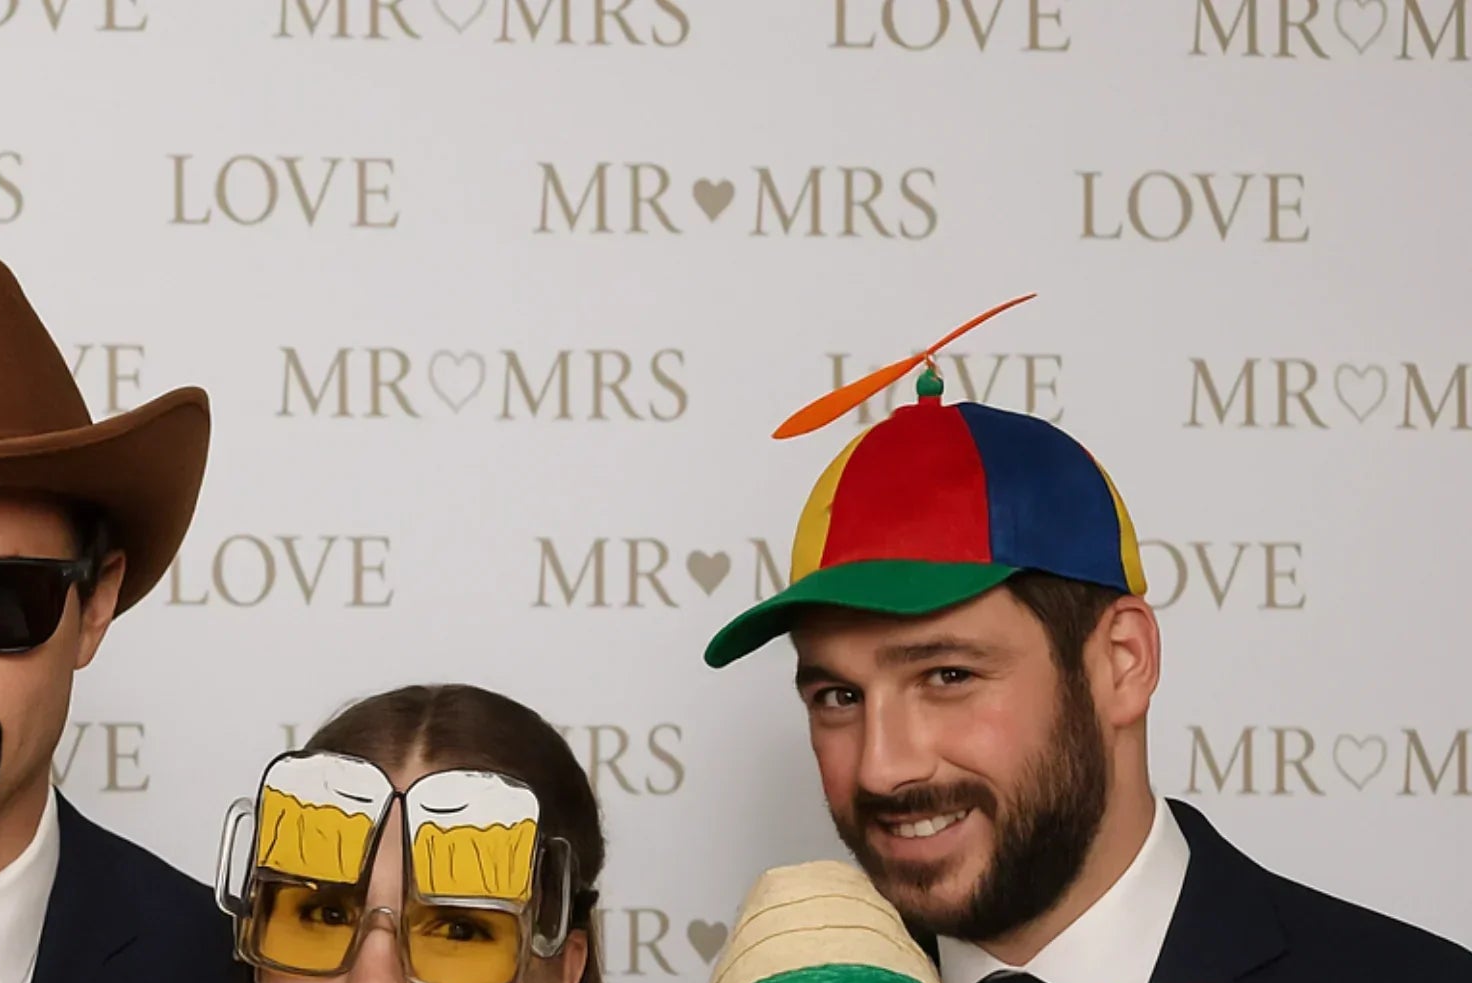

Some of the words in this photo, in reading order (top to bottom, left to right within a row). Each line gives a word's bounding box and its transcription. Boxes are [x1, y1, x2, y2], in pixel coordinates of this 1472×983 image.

[493, 0, 691, 48] MRS
[827, 0, 1071, 53] LOVE
[1188, 0, 1331, 60] MR
[167, 153, 400, 229] LOVE
[532, 161, 684, 236] MR
[748, 165, 939, 241] MRS
[1075, 169, 1311, 243] LOVE
[275, 346, 423, 420] MR
[496, 347, 690, 423] MRS
[1182, 356, 1331, 431] MR
[163, 533, 395, 609] LOVE
[530, 536, 681, 610] MR
[1138, 539, 1307, 612] OVE
[560, 723, 687, 797] RS
[1184, 725, 1327, 797] MR
[594, 907, 680, 977] R
